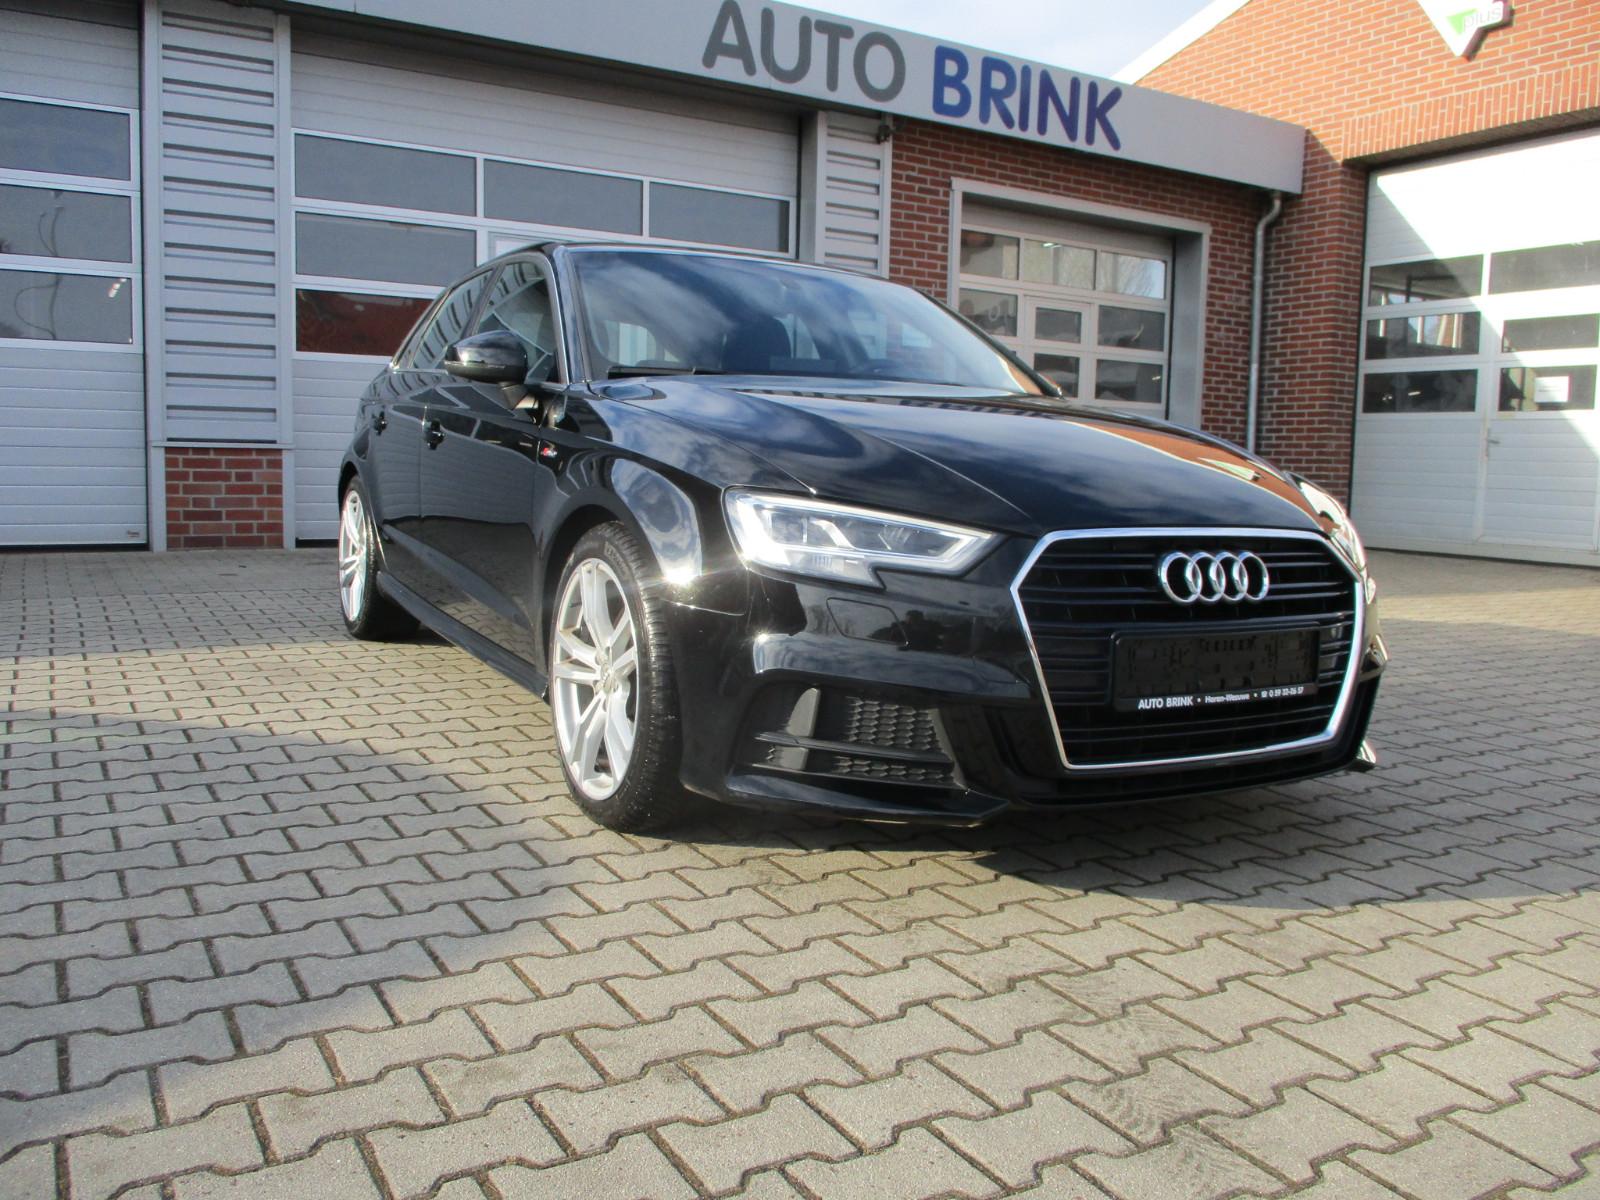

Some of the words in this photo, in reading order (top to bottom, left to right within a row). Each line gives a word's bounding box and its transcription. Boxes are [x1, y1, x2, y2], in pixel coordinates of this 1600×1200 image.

[702, 0, 906, 102] AUTO
[932, 45, 1123, 151] BRINK
[1138, 698, 1164, 710] AUTO
[1166, 696, 1194, 708] BRINK
